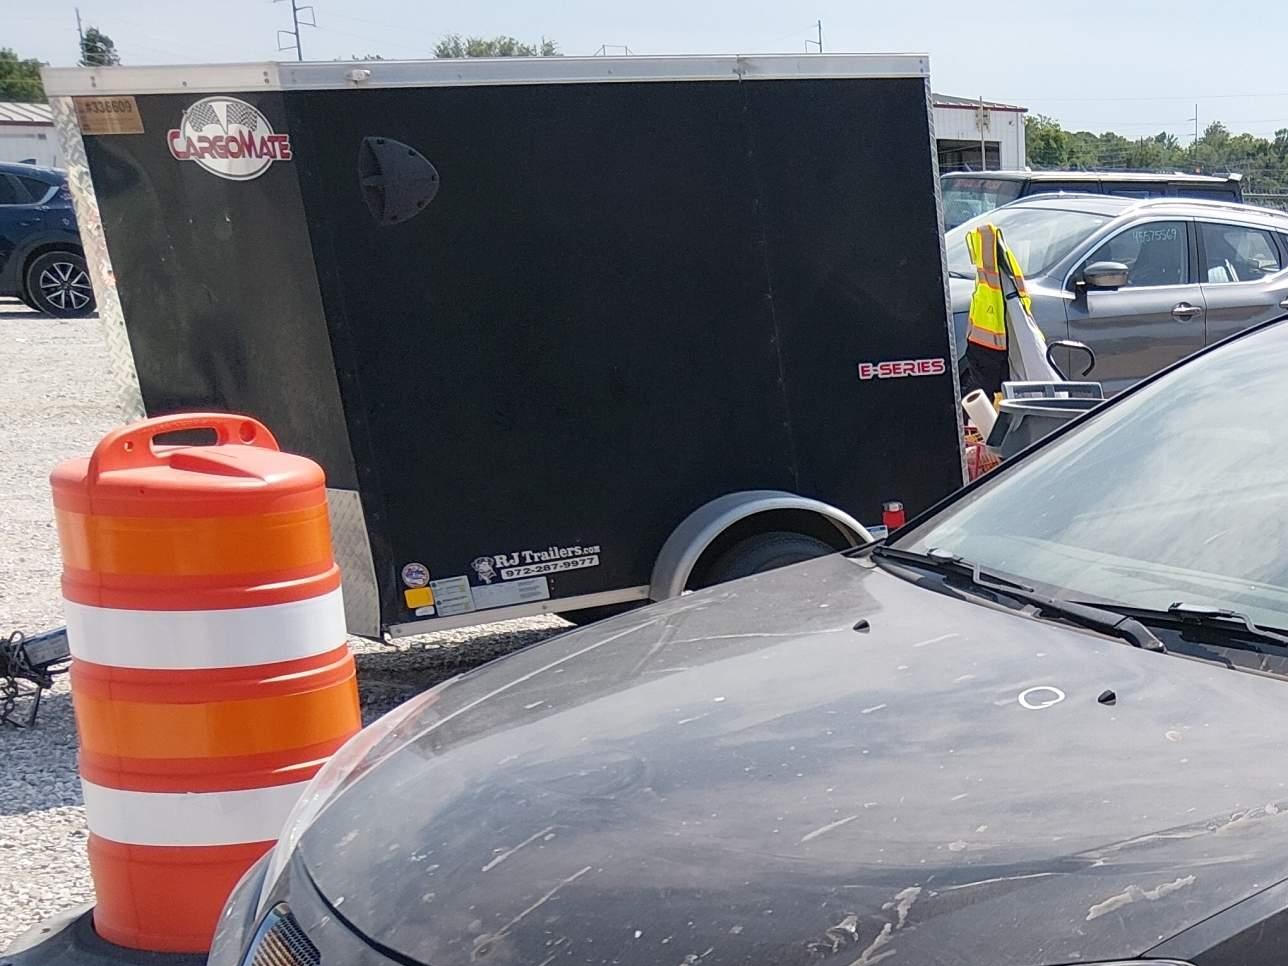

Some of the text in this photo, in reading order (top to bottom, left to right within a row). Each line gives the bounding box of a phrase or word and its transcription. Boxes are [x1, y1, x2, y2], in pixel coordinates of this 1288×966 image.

[860, 360, 944, 378] E-SERIES
[494, 551, 520, 568] RJ
[505, 557, 594, 578] 972-287-9977
